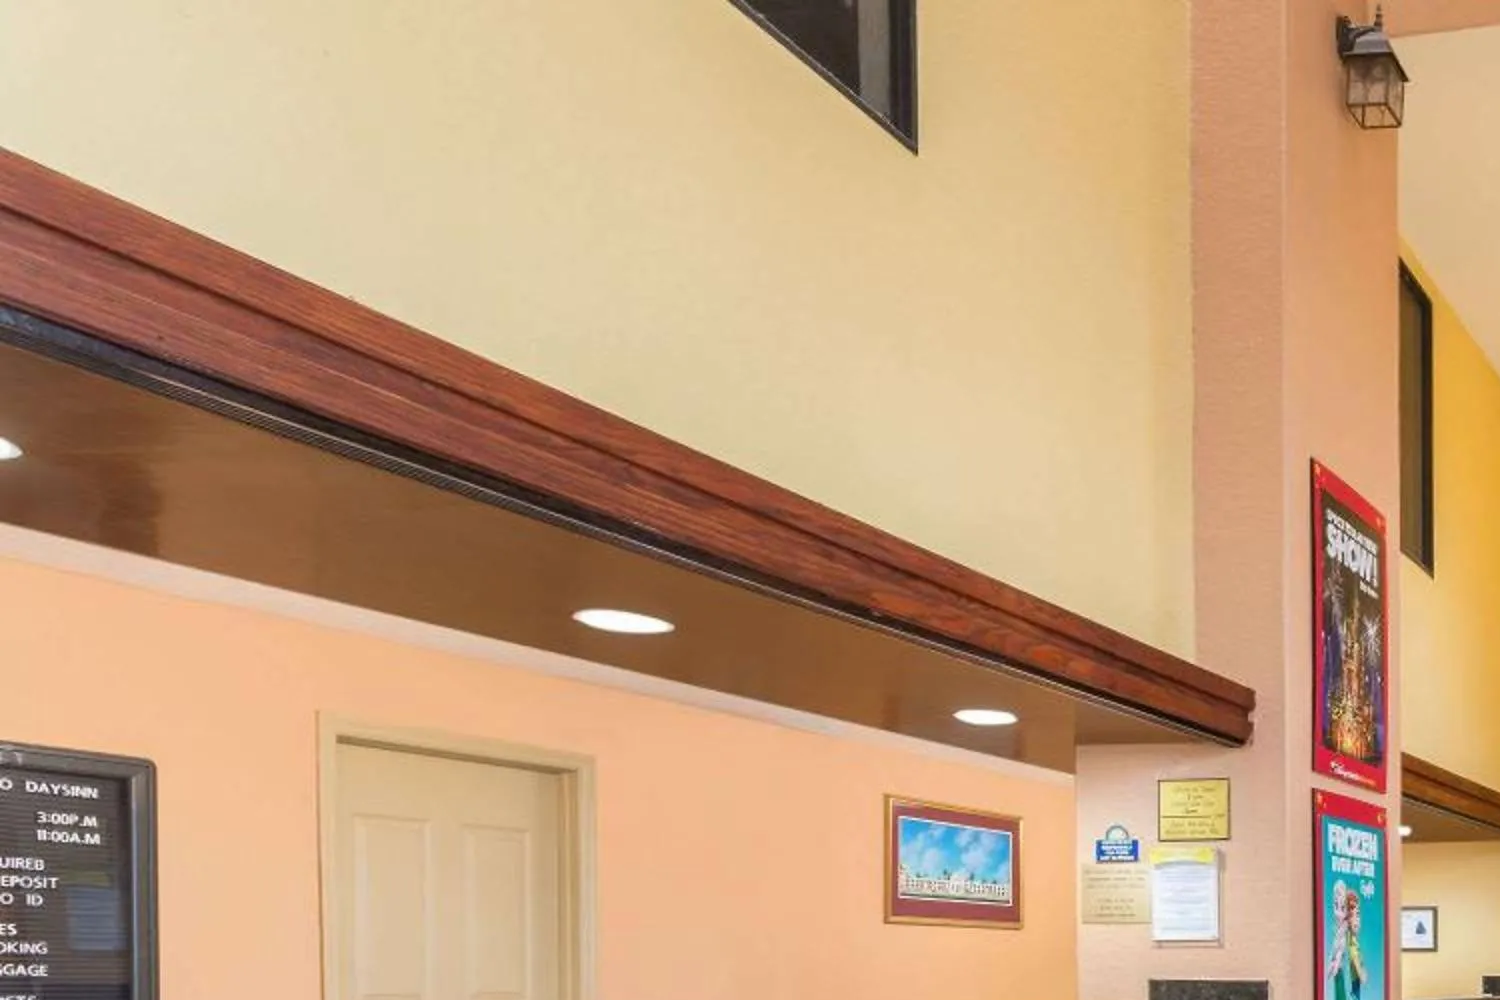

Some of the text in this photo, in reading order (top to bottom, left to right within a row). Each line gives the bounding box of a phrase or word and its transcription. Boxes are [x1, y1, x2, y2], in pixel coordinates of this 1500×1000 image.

[1326, 522, 1378, 588] SHOW!
[1327, 823, 1379, 861] FROZEN
[1, 875, 59, 889] EPOSIT
[26, 893, 43, 906] ID
[0, 963, 48, 976] GAGE
